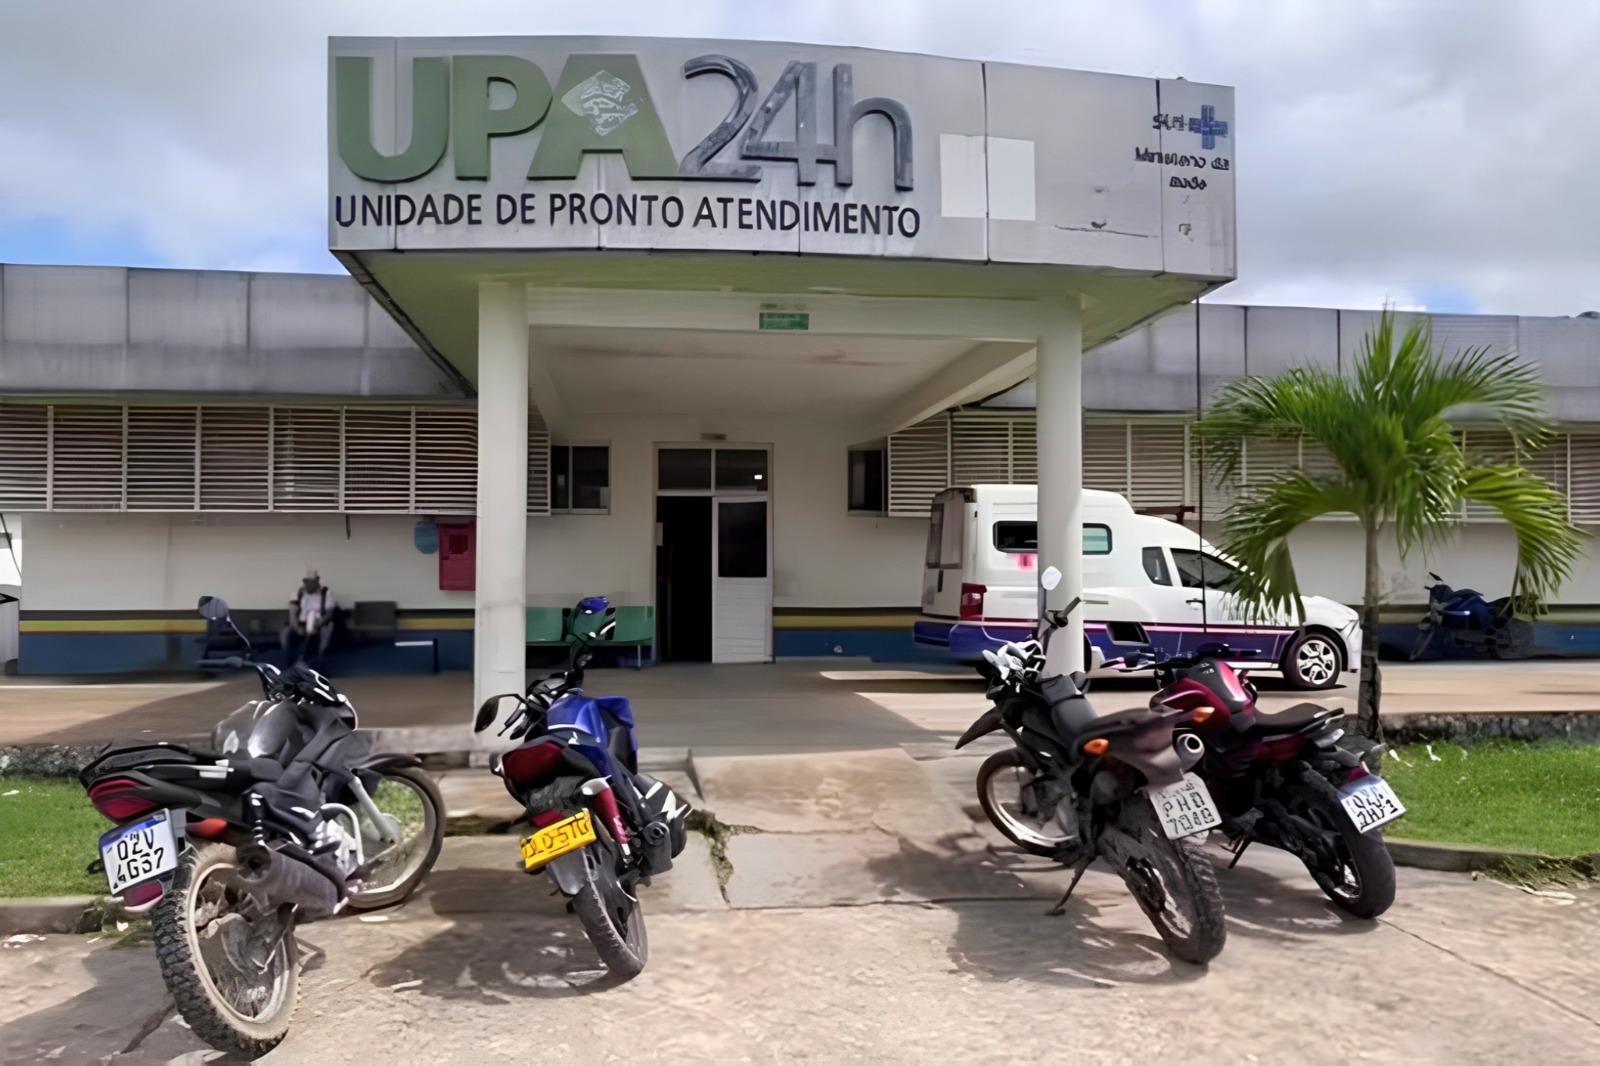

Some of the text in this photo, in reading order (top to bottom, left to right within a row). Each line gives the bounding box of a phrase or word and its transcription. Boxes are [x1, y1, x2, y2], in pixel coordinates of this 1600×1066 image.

[335, 54, 914, 192] UPA 24h
[335, 193, 921, 238] UNIDADE DE PRONTO ATENDIMENTO
